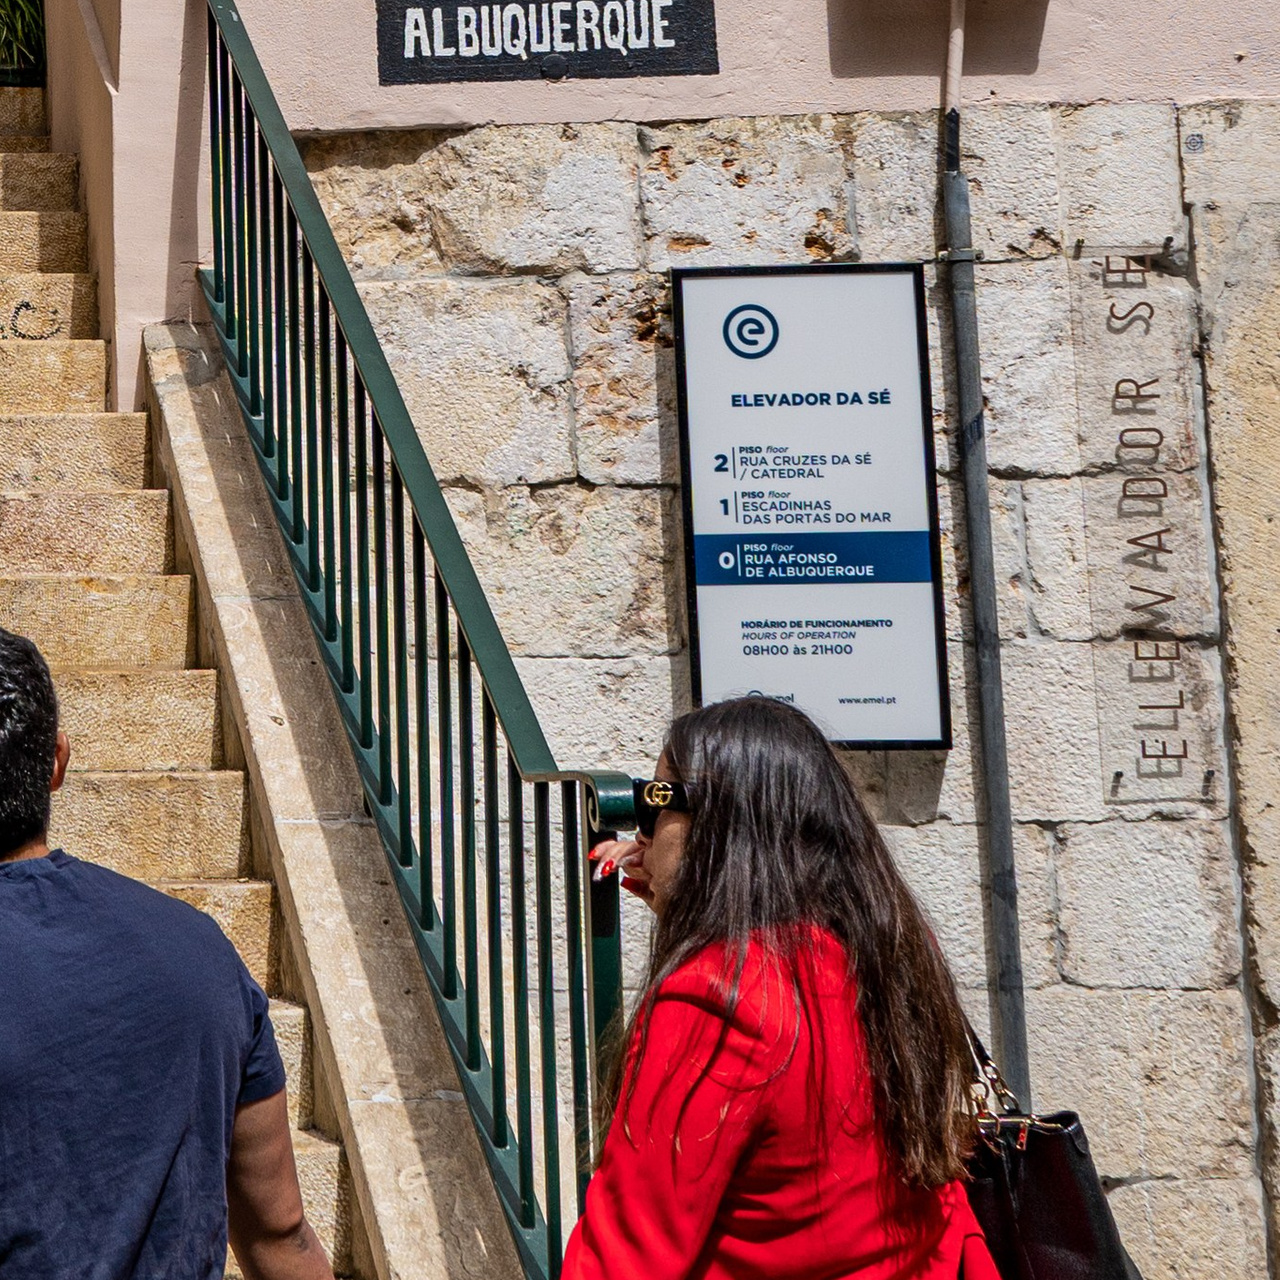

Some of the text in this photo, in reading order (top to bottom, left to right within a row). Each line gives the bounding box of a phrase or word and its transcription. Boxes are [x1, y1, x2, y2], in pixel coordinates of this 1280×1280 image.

[731, 388, 892, 408] ELEVADOR DA SÉ
[739, 445, 789, 454] PISO floor
[714, 453, 729, 472] 2
[740, 451, 872, 467] RUA CRUZES DA SÉ
[740, 467, 825, 481] / CATEDRAL
[741, 490, 791, 499] PISO floor
[719, 498, 729, 516] 1
[742, 500, 832, 512] ESCADINHAS
[743, 512, 892, 524] DAS PORTAS DO MAR
[743, 543, 794, 552] PISO floor
[718, 552, 735, 569] 0
[744, 553, 838, 565] RUA AFONSO
[745, 565, 875, 577] DE ALBUQUERQUE
[741, 619, 893, 629] HORÁRIO DE FUNCIONAMENTO
[742, 631, 857, 640] HOURS OF OPERATION
[743, 644, 853, 656] 08H00 às 21H00
[838, 696, 897, 705] www.emel.pt
